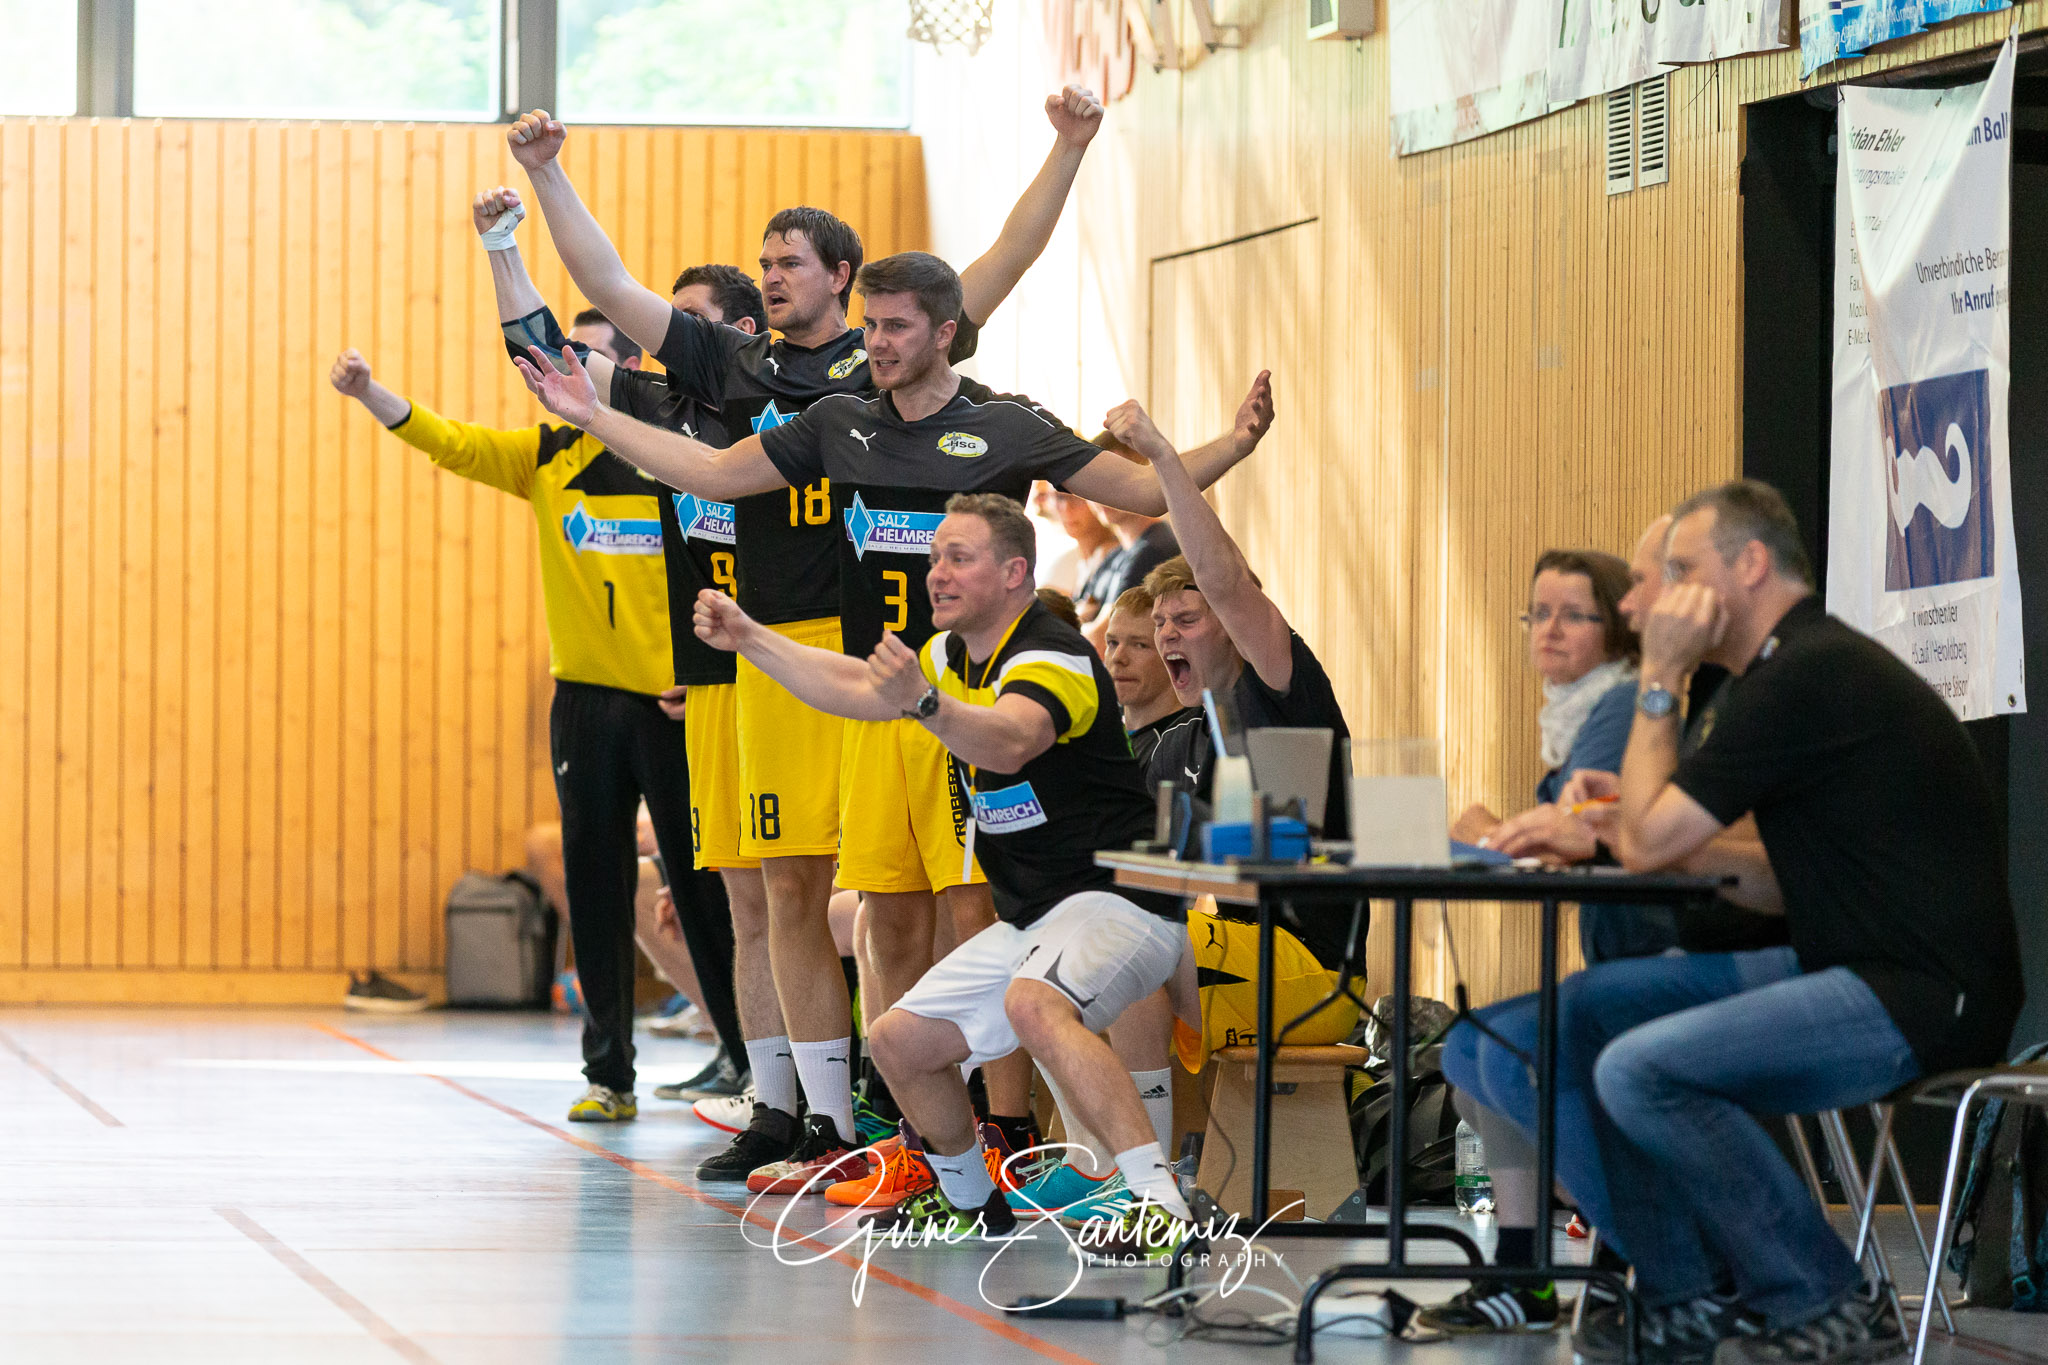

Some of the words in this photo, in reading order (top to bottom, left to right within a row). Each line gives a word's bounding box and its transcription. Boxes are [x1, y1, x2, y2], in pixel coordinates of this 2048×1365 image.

[1950, 291, 1963, 315] Ihr
[1964, 283, 1995, 312] Anruf
[949, 440, 977, 450] HSG
[705, 504, 732, 520] SALZ
[789, 477, 831, 527] 18
[876, 513, 910, 529] SALZ
[595, 520, 620, 534] SALZ
[711, 552, 738, 601] 9
[603, 580, 616, 630] 1
[882, 570, 908, 632] 3
[749, 792, 781, 841] 18
